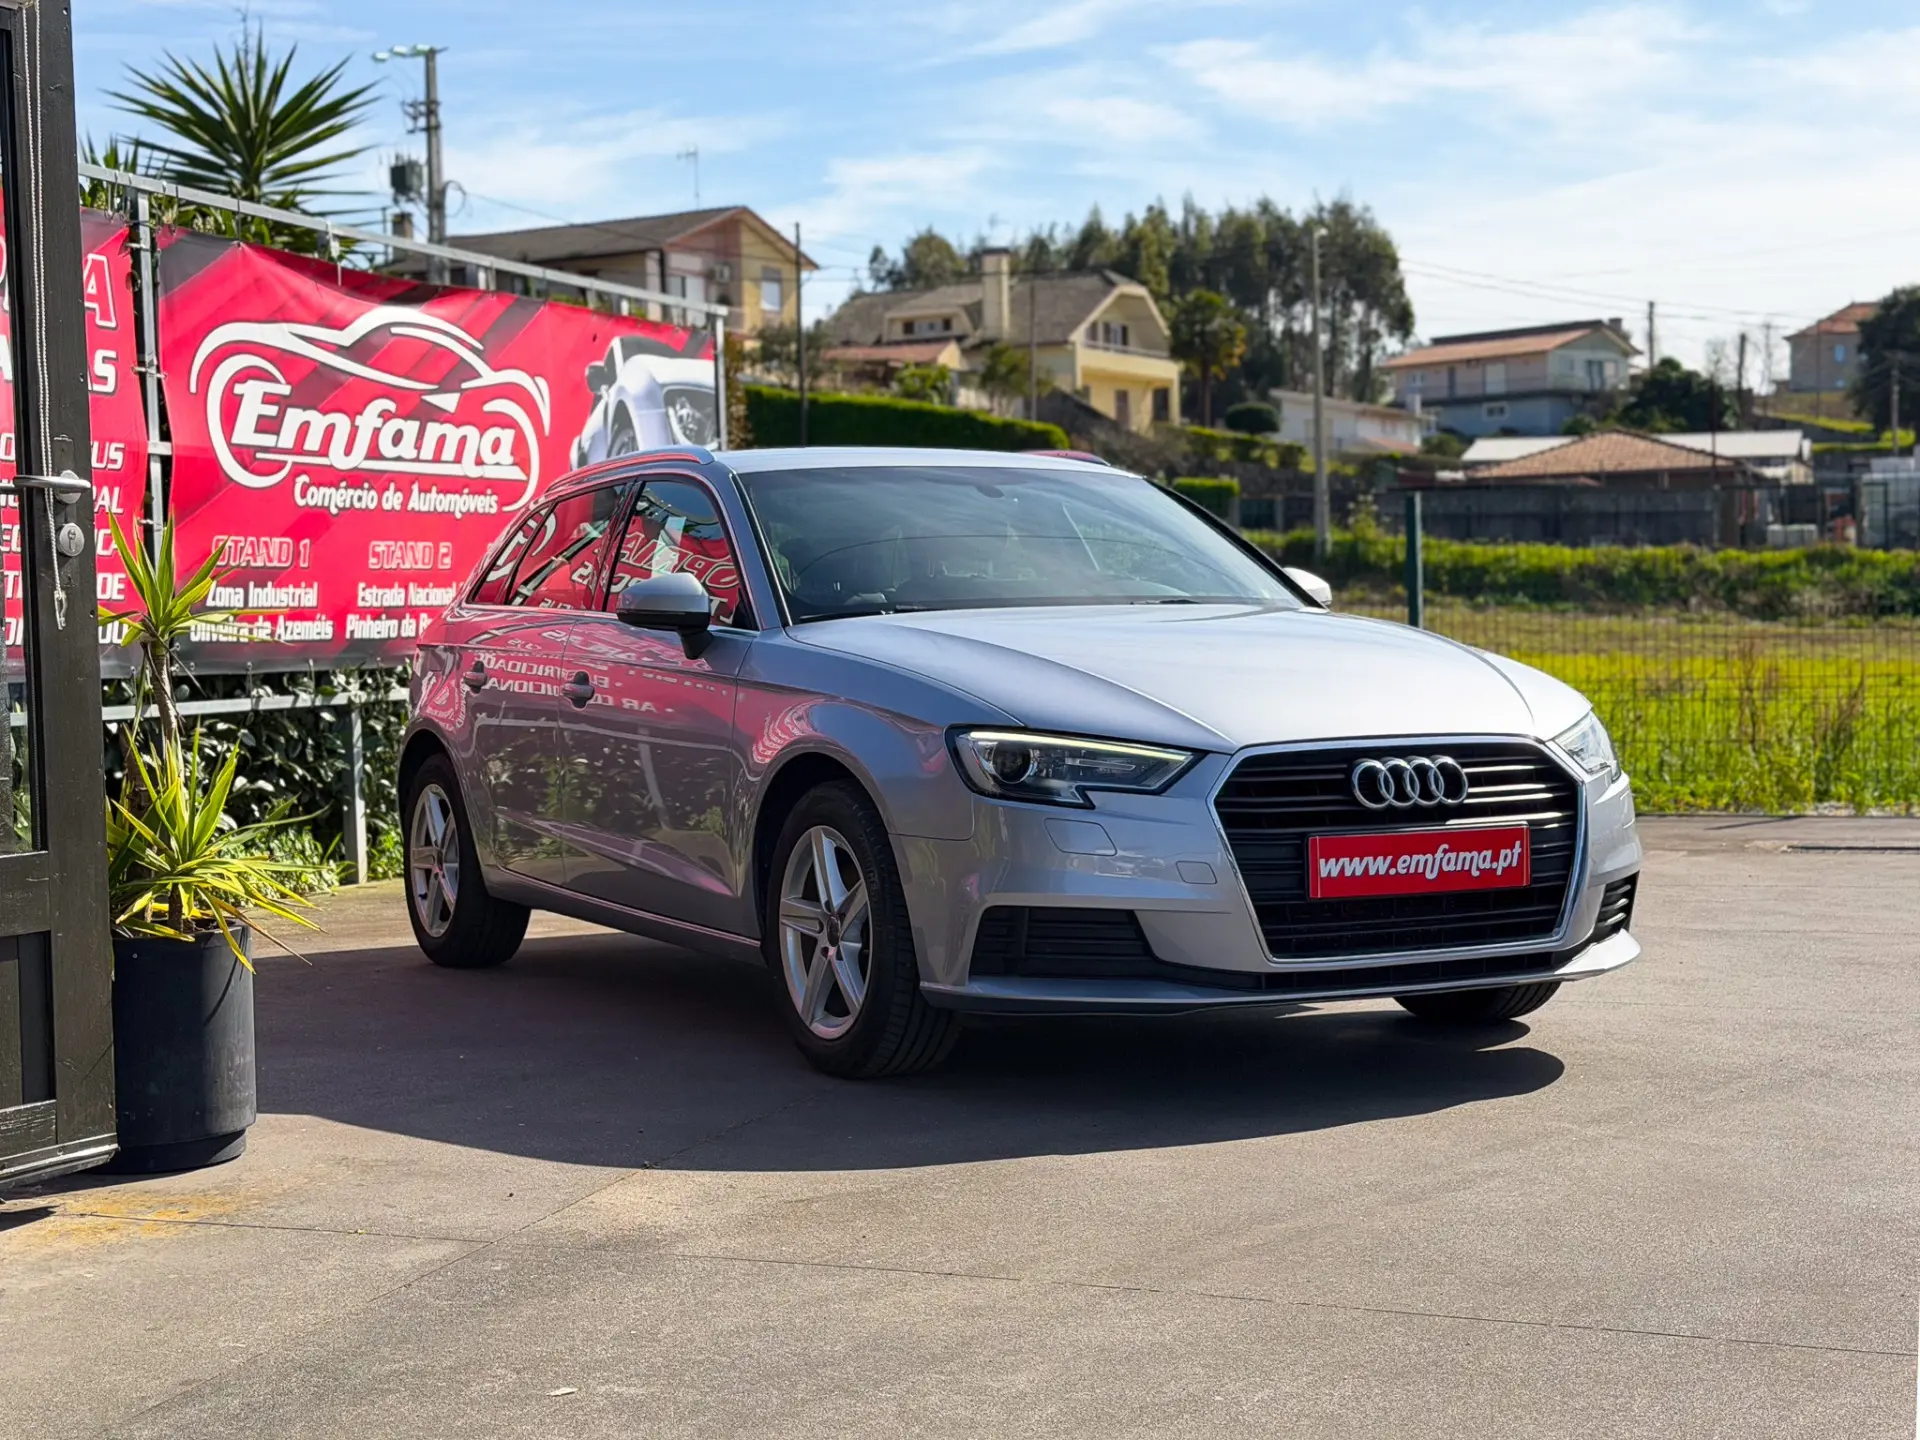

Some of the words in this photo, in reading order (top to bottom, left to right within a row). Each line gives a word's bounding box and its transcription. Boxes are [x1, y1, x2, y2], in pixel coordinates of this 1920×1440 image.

[230, 379, 517, 477] Emfama
[294, 474, 378, 515] Comércio
[382, 482, 403, 511] de
[407, 480, 498, 519] Automóveis
[299, 538, 310, 568] 1
[368, 540, 434, 569] STAND
[438, 542, 452, 569] 2
[206, 580, 244, 607] Zona
[248, 581, 318, 607] Industrial
[357, 582, 405, 608] Estrada
[275, 613, 334, 641] Azeméis
[345, 613, 398, 639] Pinheiro
[400, 612, 416, 638] da
[1319, 841, 1521, 880] www.emfama.pt
